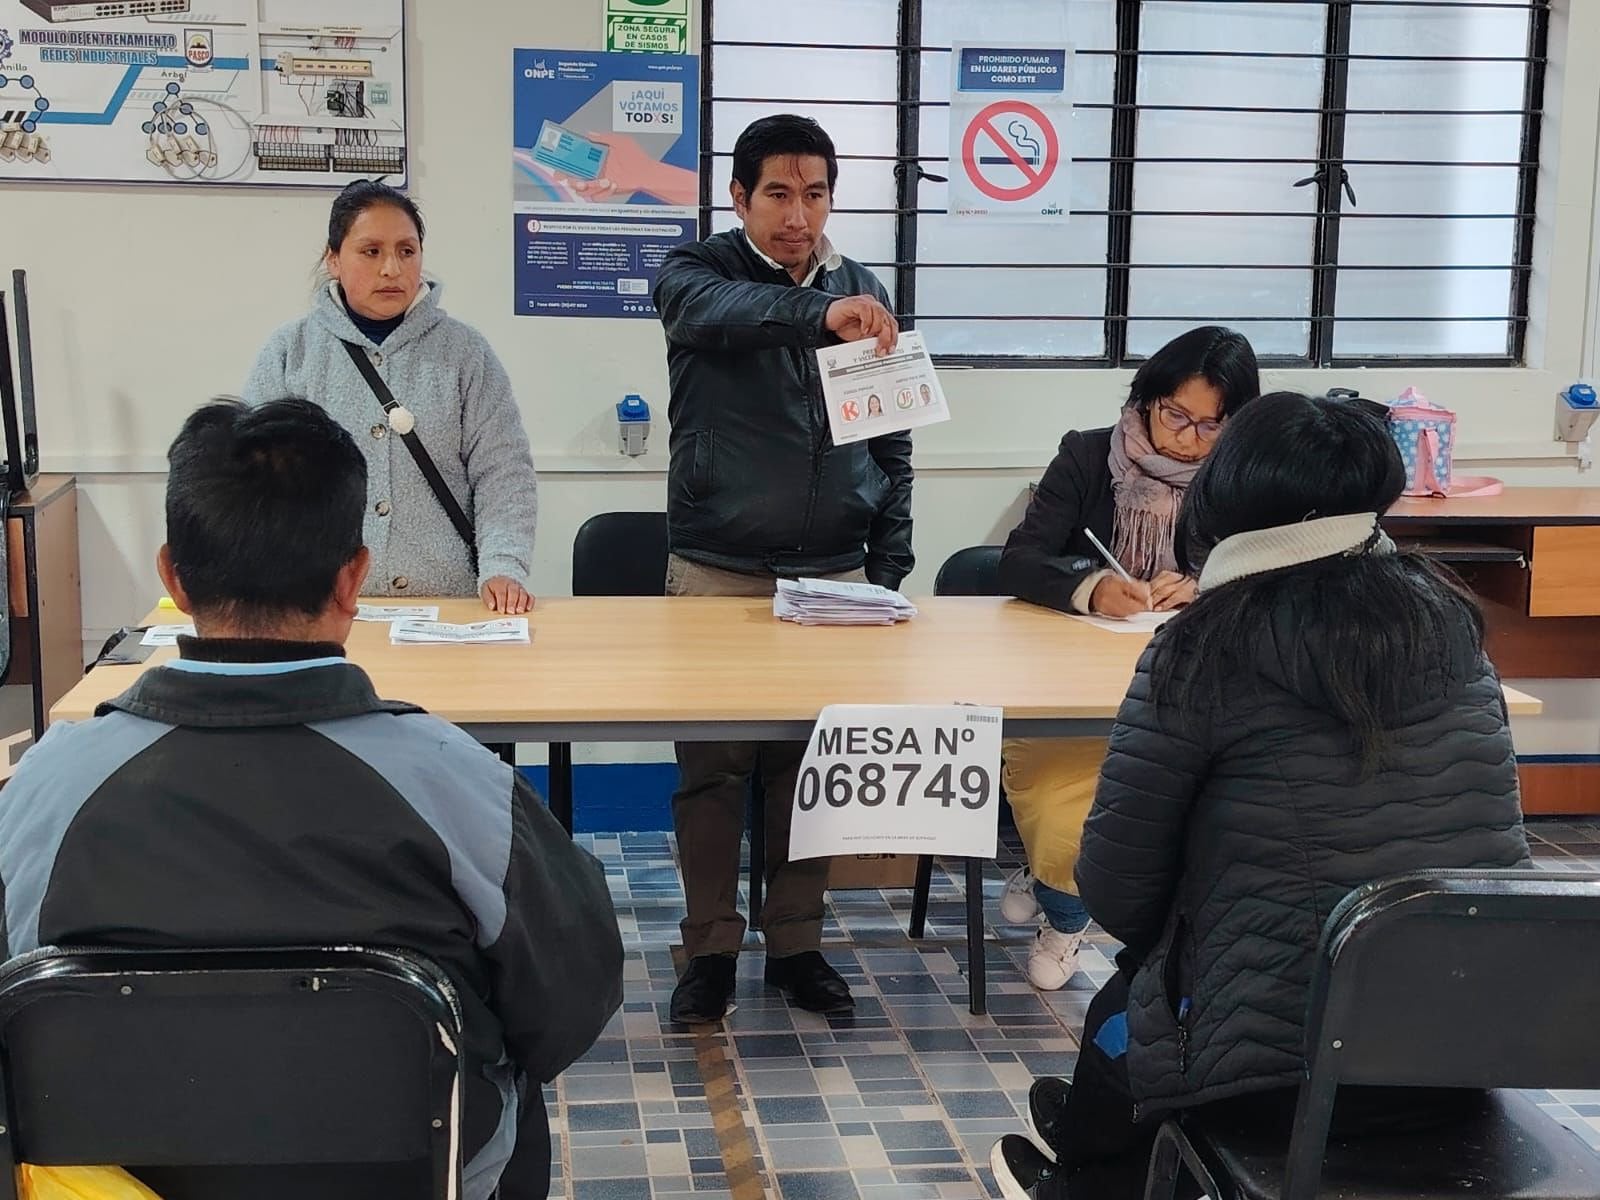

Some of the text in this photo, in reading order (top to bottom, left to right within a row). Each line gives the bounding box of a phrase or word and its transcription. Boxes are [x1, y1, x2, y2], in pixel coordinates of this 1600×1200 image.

[643, 25, 676, 33] SEGURA
[20, 30, 177, 48] MODULO DE ENTRENAMIENTO
[42, 48, 157, 65] REDES INDUSTRIALES
[188, 50, 210, 61] PASCO
[978, 55, 1050, 64] PROHIBIDO FUMAR
[524, 69, 555, 79] ONPE
[970, 64, 1057, 74] EN LUGARES PÚBLICOS
[991, 75, 1036, 83] COMO ESTE
[619, 101, 679, 112] VOTAMOS
[625, 111, 674, 124] TODXS!
[817, 726, 975, 757] MESA Nº
[797, 762, 990, 812] 068749
